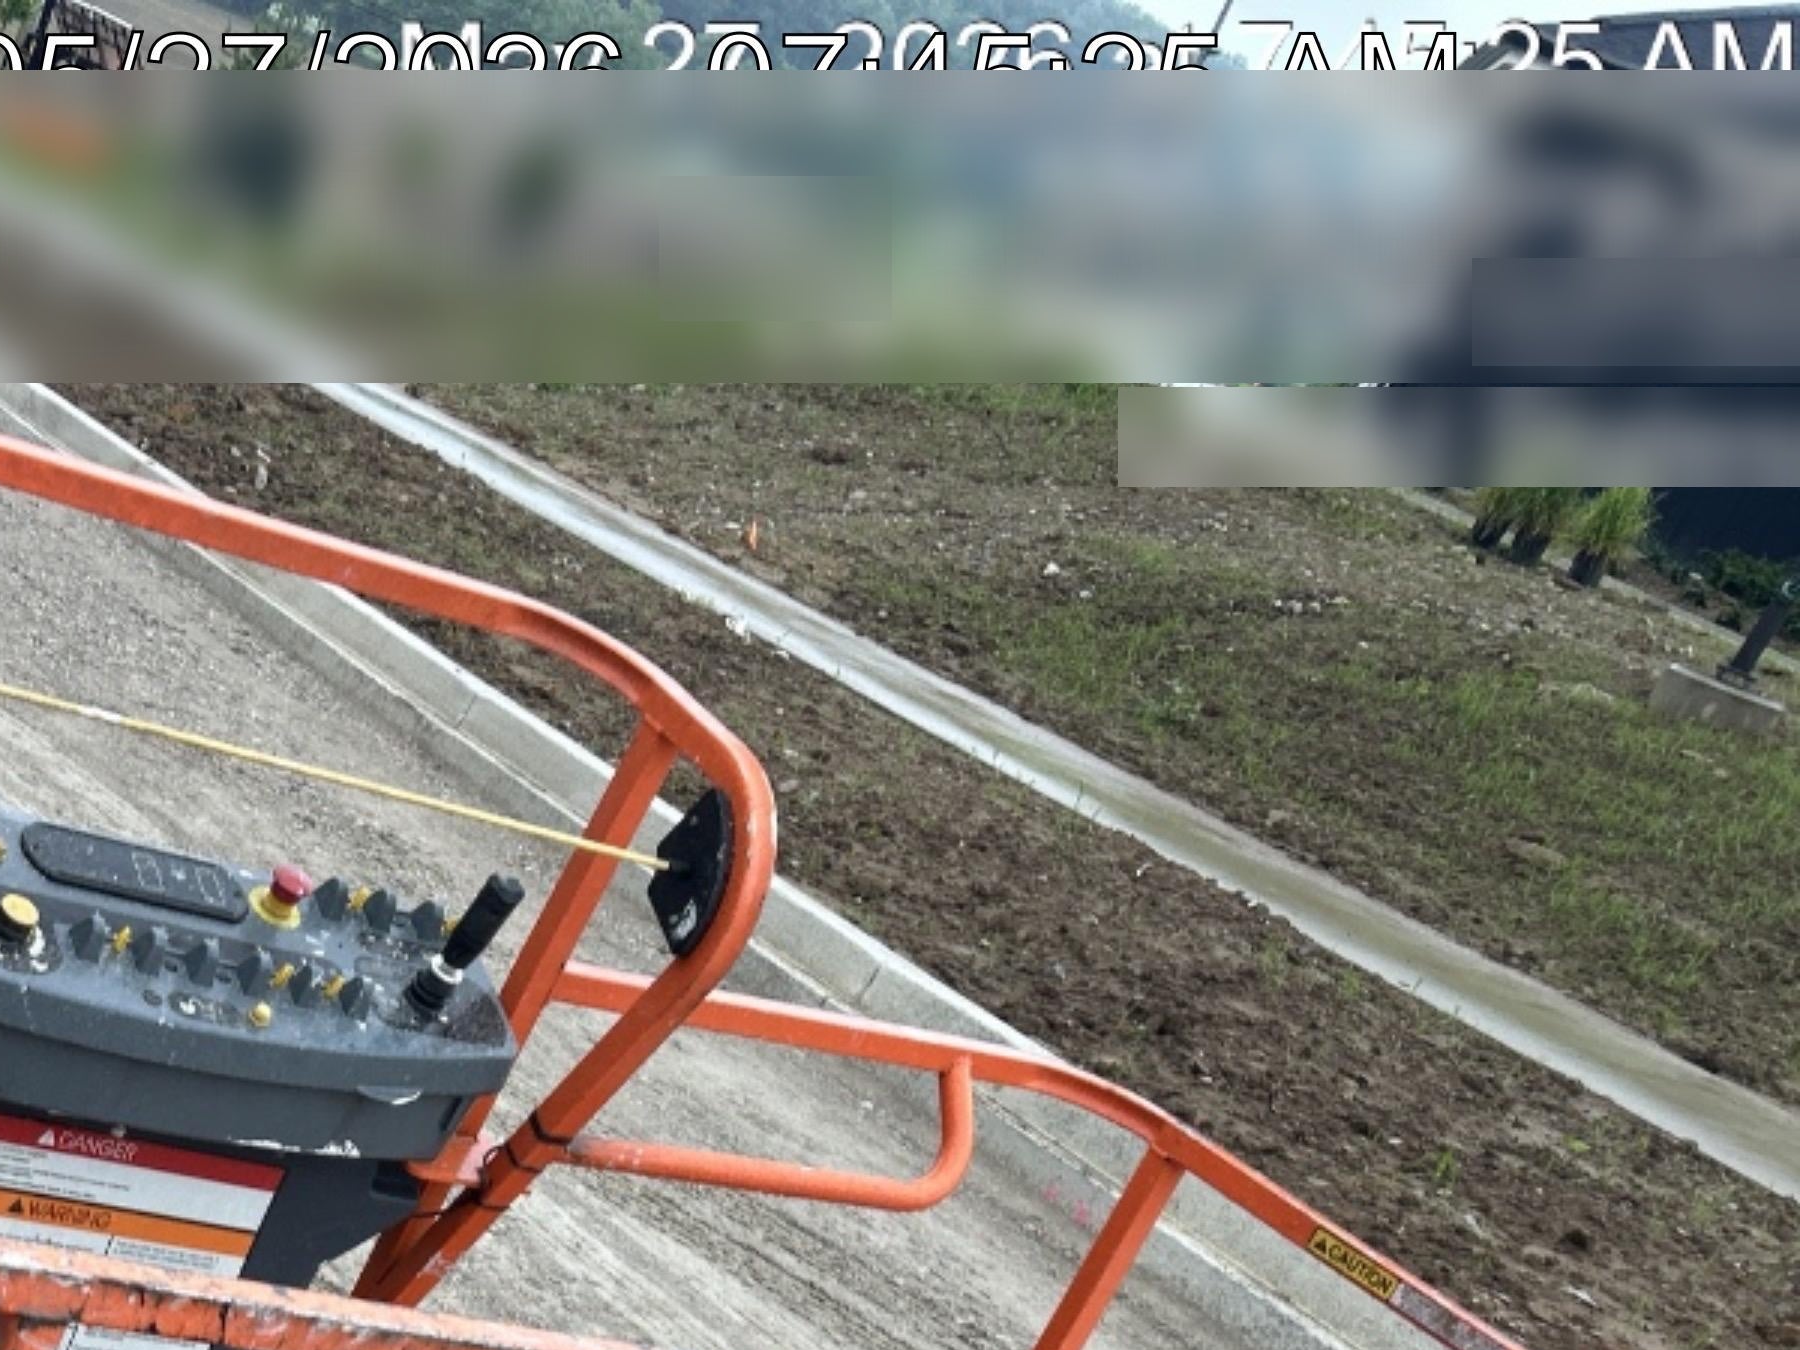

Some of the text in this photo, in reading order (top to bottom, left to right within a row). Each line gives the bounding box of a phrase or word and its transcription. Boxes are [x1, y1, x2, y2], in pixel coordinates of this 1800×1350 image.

[59, 1129, 138, 1162] DANGER
[28, 1199, 112, 1229] WARNING
[1328, 1244, 1394, 1294] CAUTION
